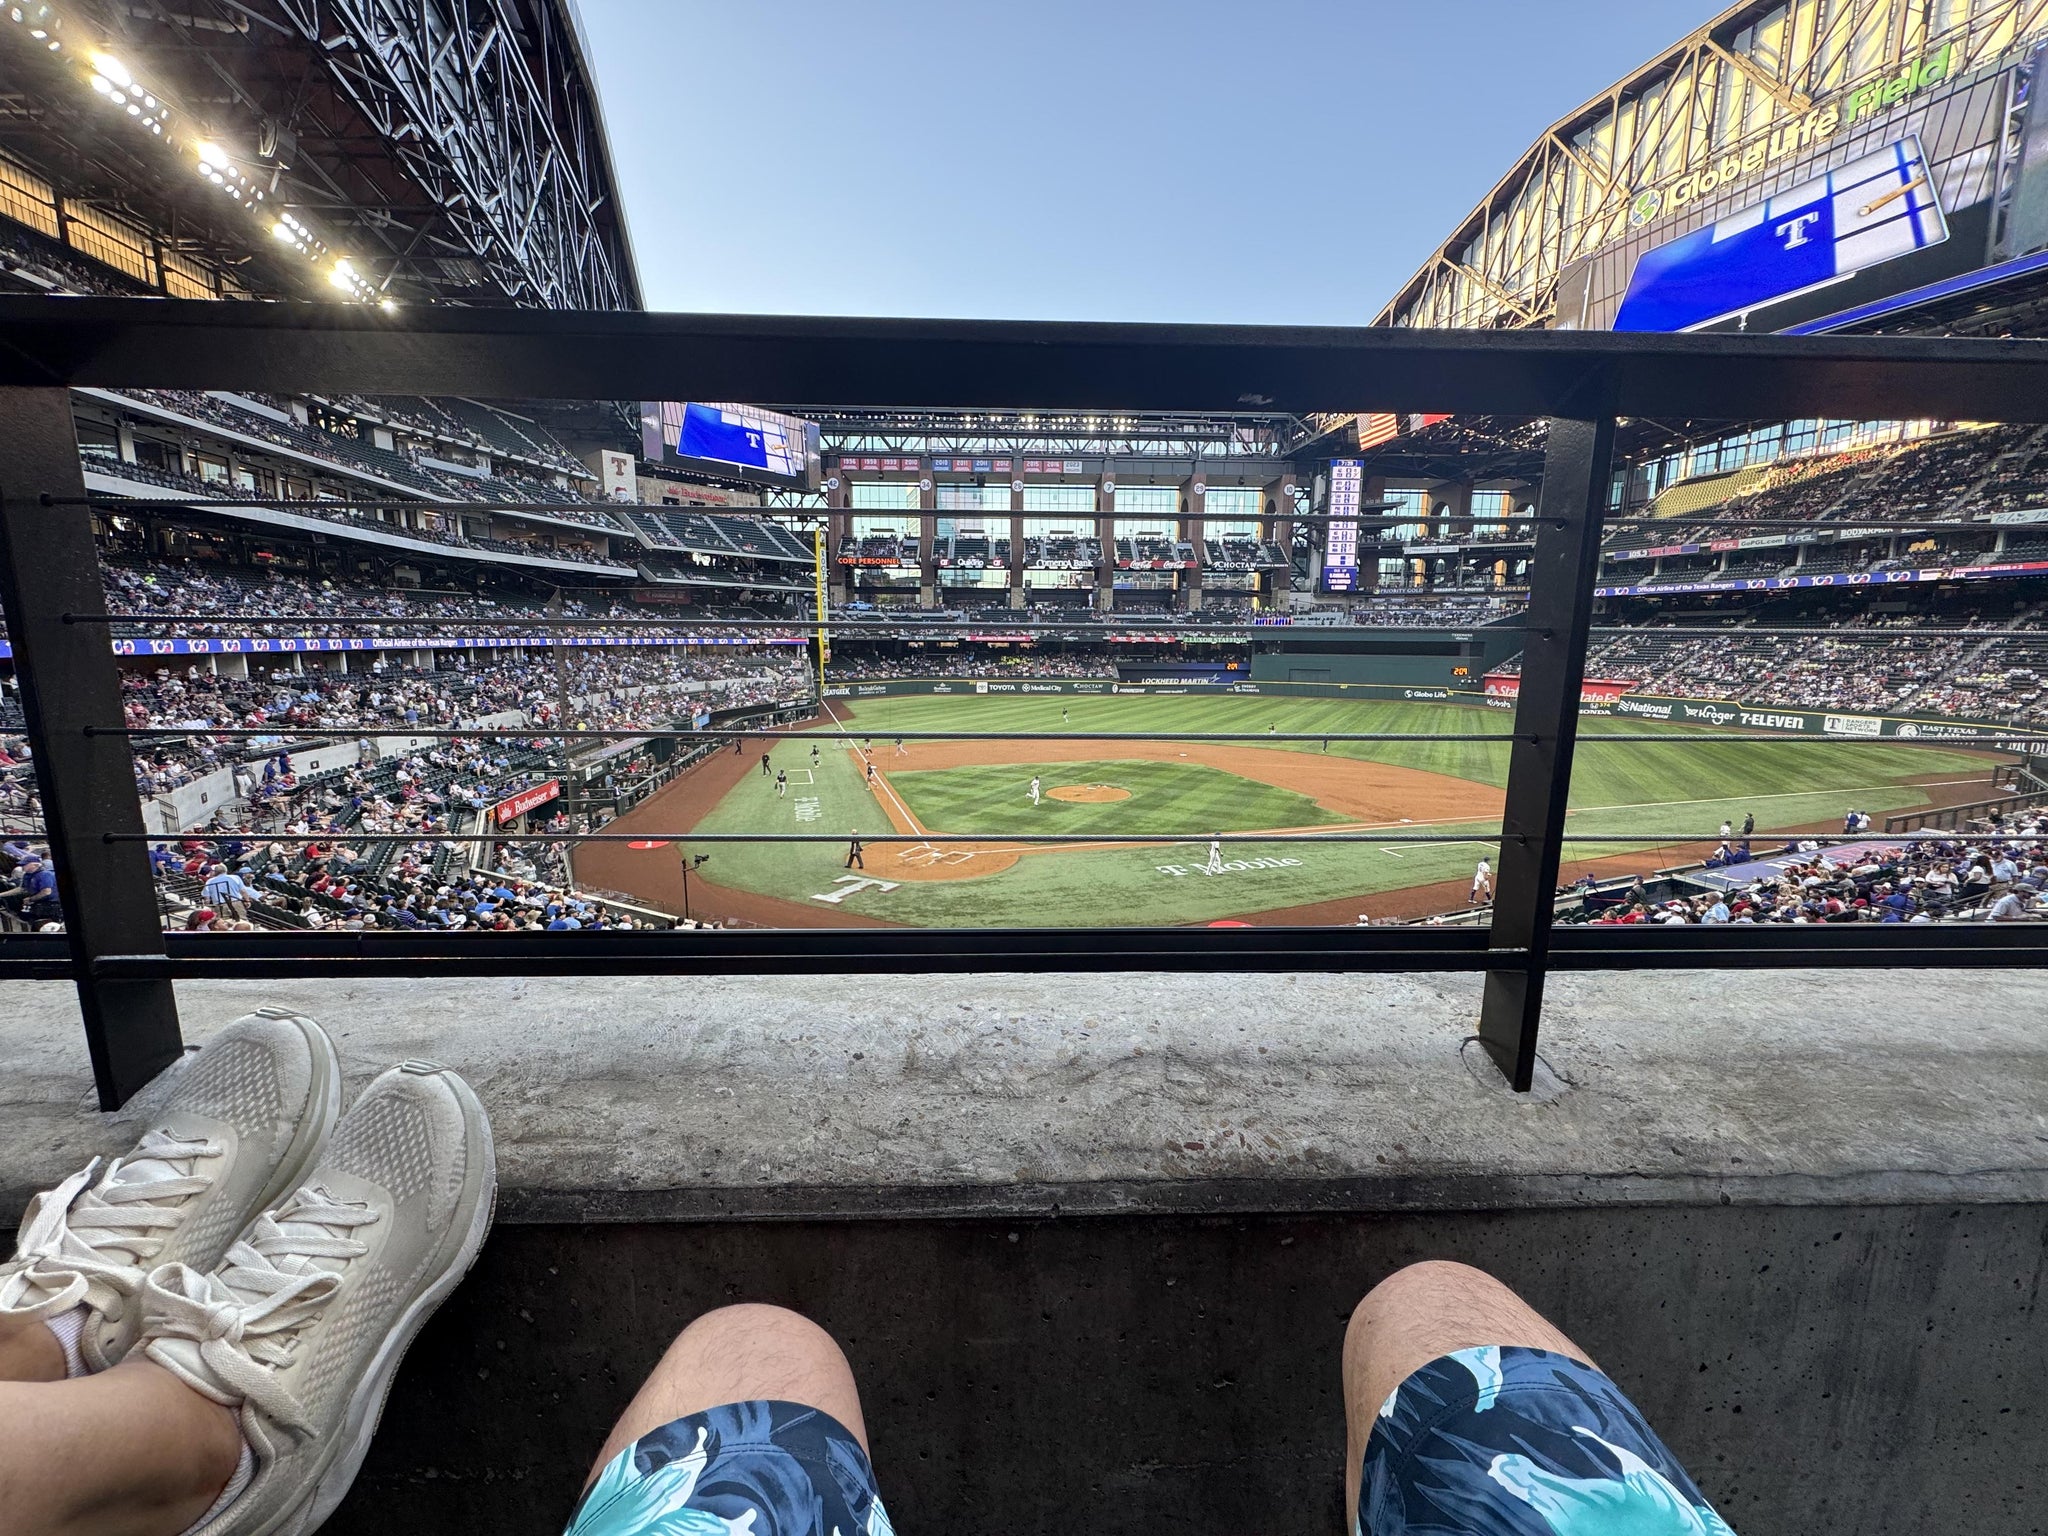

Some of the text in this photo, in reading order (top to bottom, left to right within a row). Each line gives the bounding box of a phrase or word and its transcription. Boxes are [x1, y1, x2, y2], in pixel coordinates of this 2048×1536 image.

[1670, 42, 1951, 206] Globe Life Field
[1775, 211, 1819, 251] T
[745, 432, 760, 448] T
[611, 456, 627, 476] T
[838, 557, 857, 565] CORE
[858, 557, 900, 565] PERSONNEL
[1073, 559, 1094, 567] Bank
[1218, 560, 1257, 568] CHOCTAW
[1636, 585, 1656, 593] Official
[1693, 582, 1710, 590] Texas
[1711, 581, 1736, 590] Rangers
[111, 639, 135, 655] 00
[373, 638, 459, 648] Official Airline of the Texas Rangers
[1453, 667, 1468, 676] 2:09
[822, 687, 850, 697] SEATGEEK
[1051, 685, 1063, 693] City
[1434, 691, 1447, 699] Life
[1580, 691, 1618, 702] tate Fa
[1487, 698, 1511, 708] Kubota
[1629, 701, 1672, 715] National
[1699, 705, 1735, 725] Kroger
[1827, 717, 1841, 730] T
[1946, 726, 1978, 735] TEXAS
[514, 790, 548, 814] Budweiser
[1155, 856, 1303, 877] T Mobile
[811, 875, 901, 904] T
